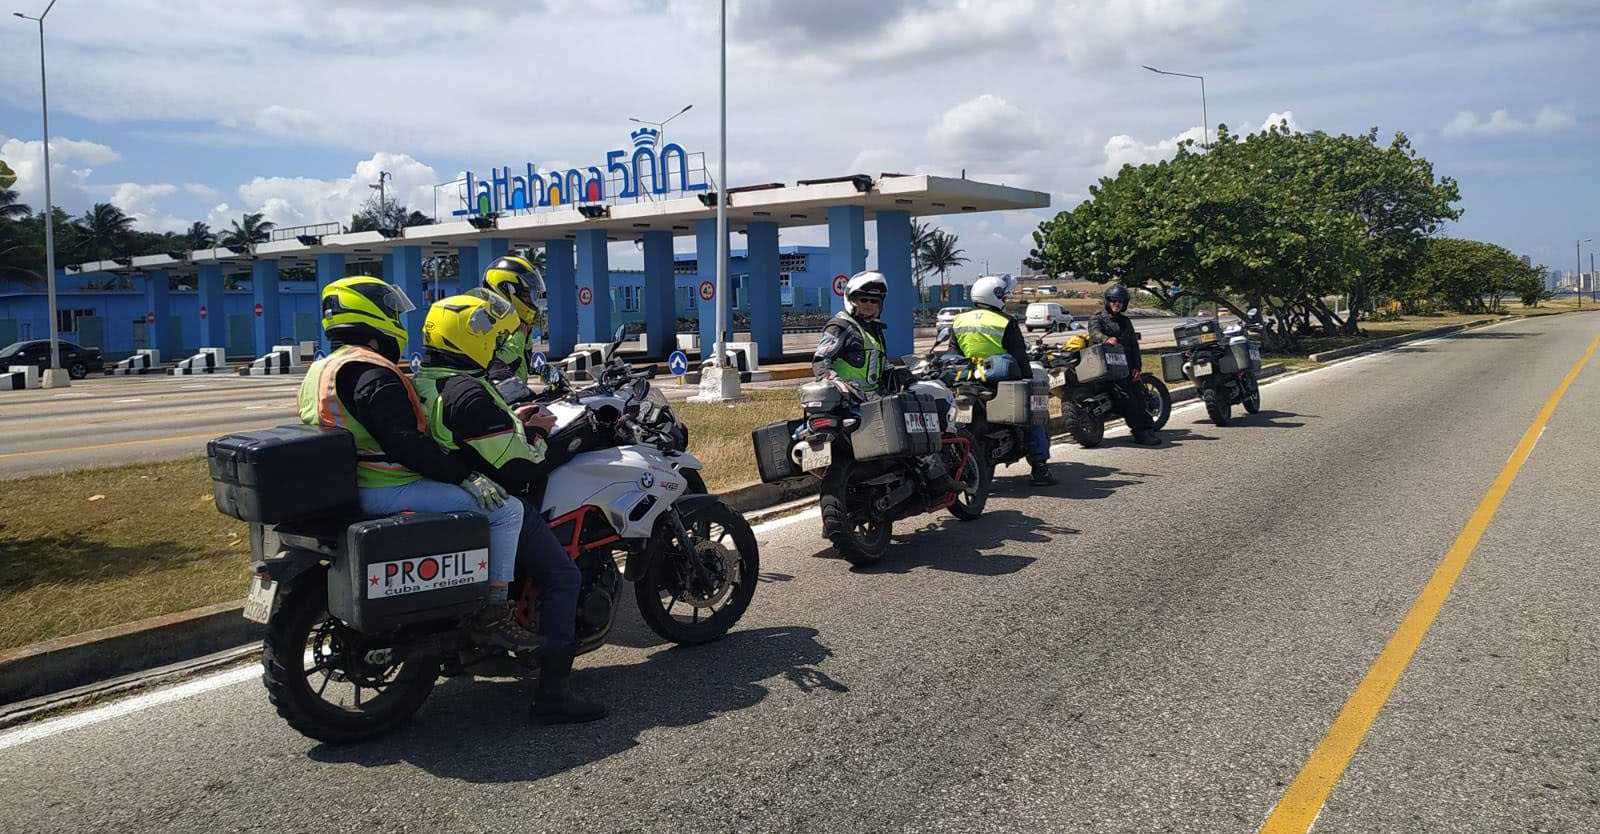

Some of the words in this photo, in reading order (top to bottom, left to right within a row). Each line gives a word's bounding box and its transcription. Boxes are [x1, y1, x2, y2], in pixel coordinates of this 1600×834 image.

[385, 553, 474, 587] PROFIL
[385, 584, 420, 596] cuba
[433, 576, 475, 588] reisen
